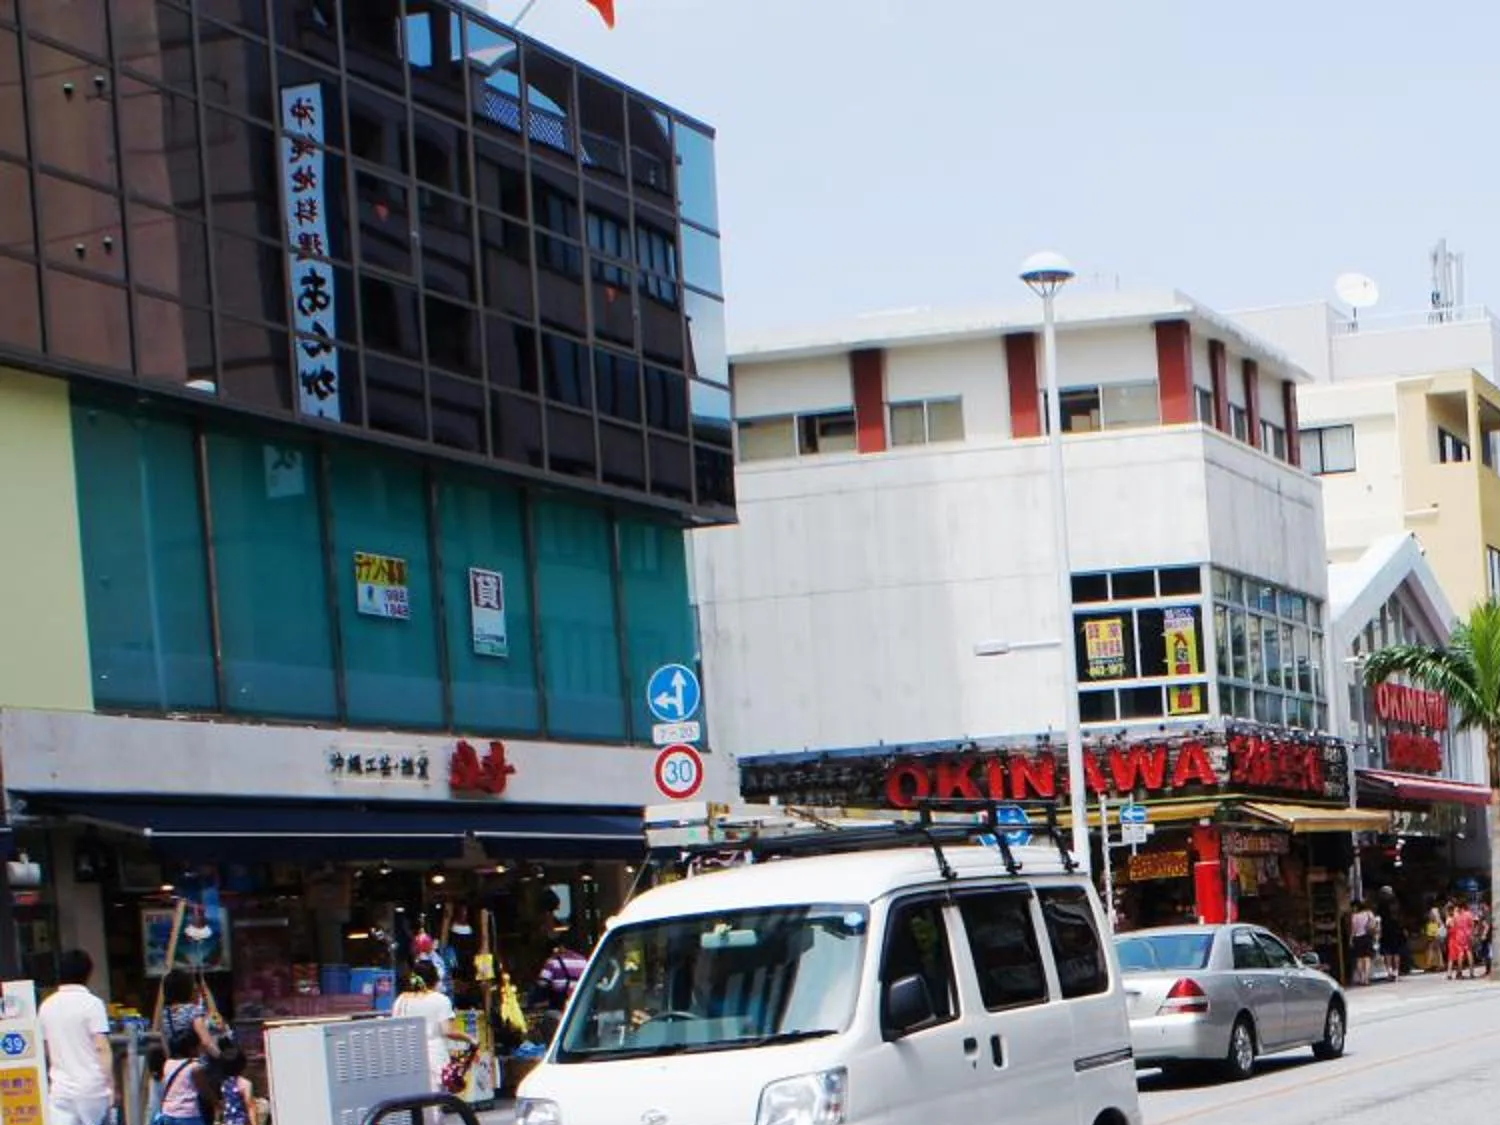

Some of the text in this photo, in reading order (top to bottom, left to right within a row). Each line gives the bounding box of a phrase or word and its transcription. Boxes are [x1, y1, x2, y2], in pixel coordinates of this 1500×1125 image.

[665, 759, 693, 784] 30
[886, 740, 1218, 808] OKINAWA
[4, 1036, 21, 1051] 39
